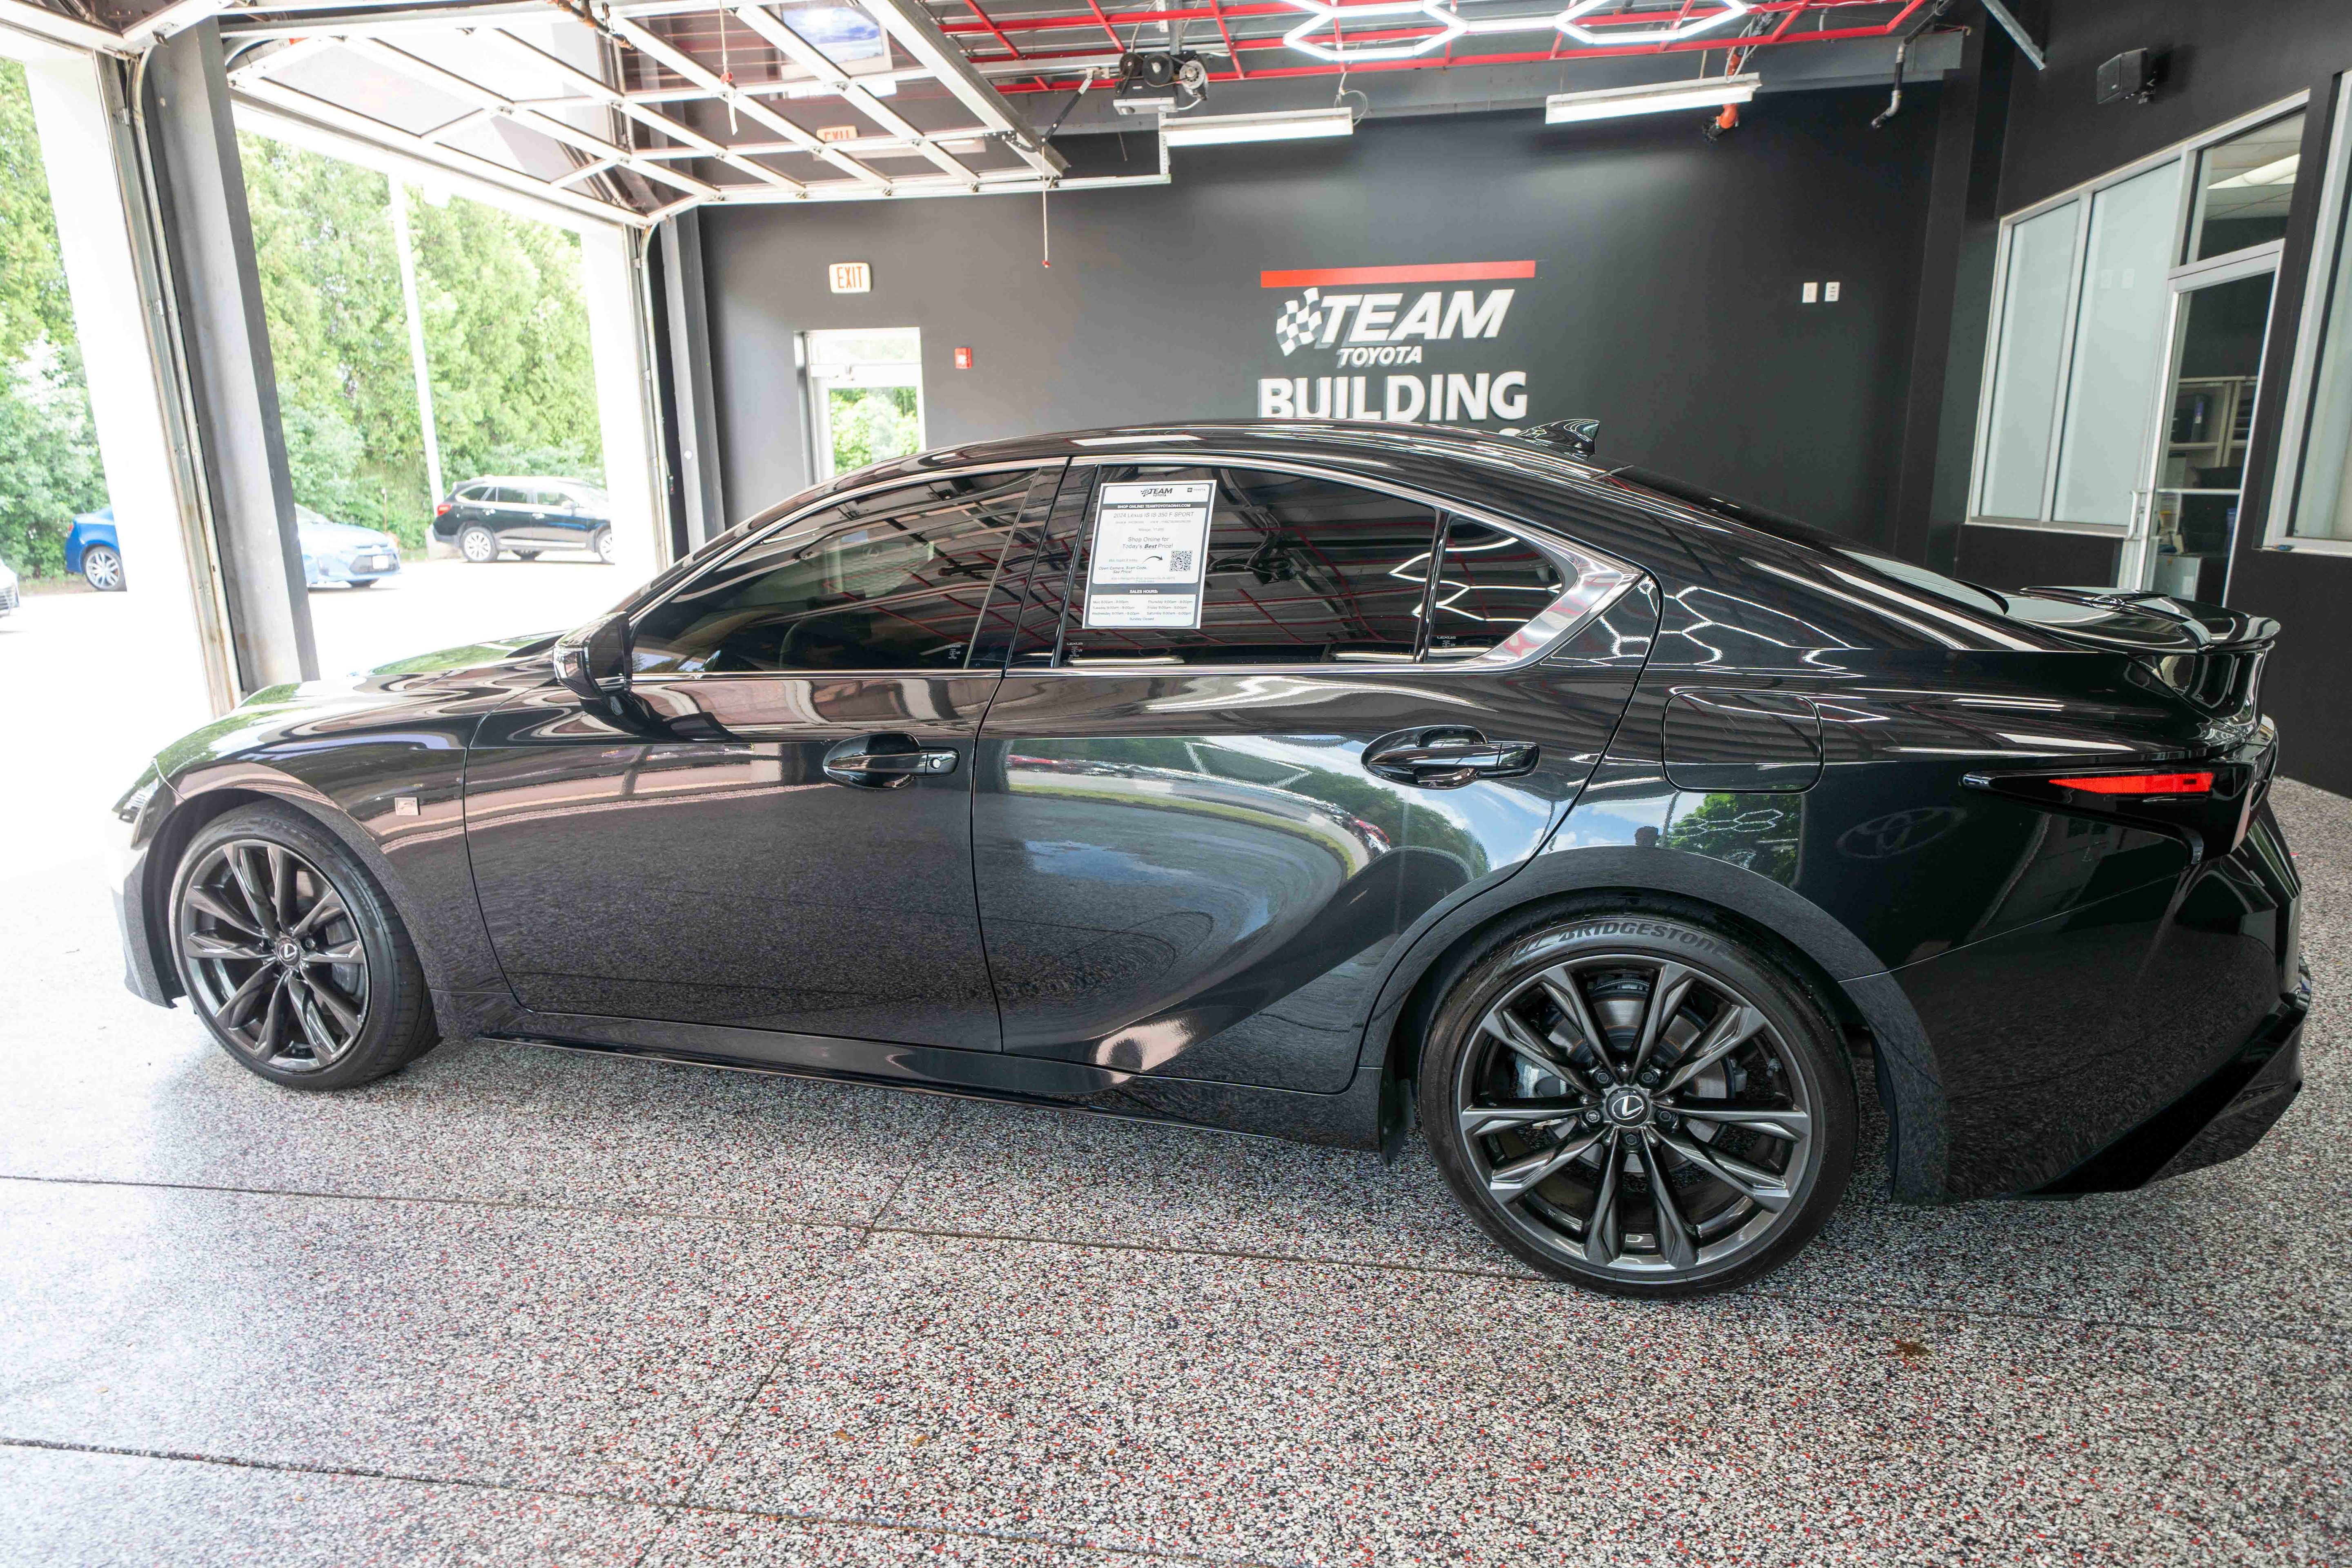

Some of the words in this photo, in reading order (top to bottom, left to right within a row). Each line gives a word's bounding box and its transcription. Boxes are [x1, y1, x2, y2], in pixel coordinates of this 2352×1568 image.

[836, 266, 862, 289] EXIT
[1316, 288, 1515, 347] TEAM
[1338, 345, 1423, 367] TOYOTA
[1258, 370, 1528, 421] BUILDING
[1558, 921, 1735, 956] BRIDGESTONE
